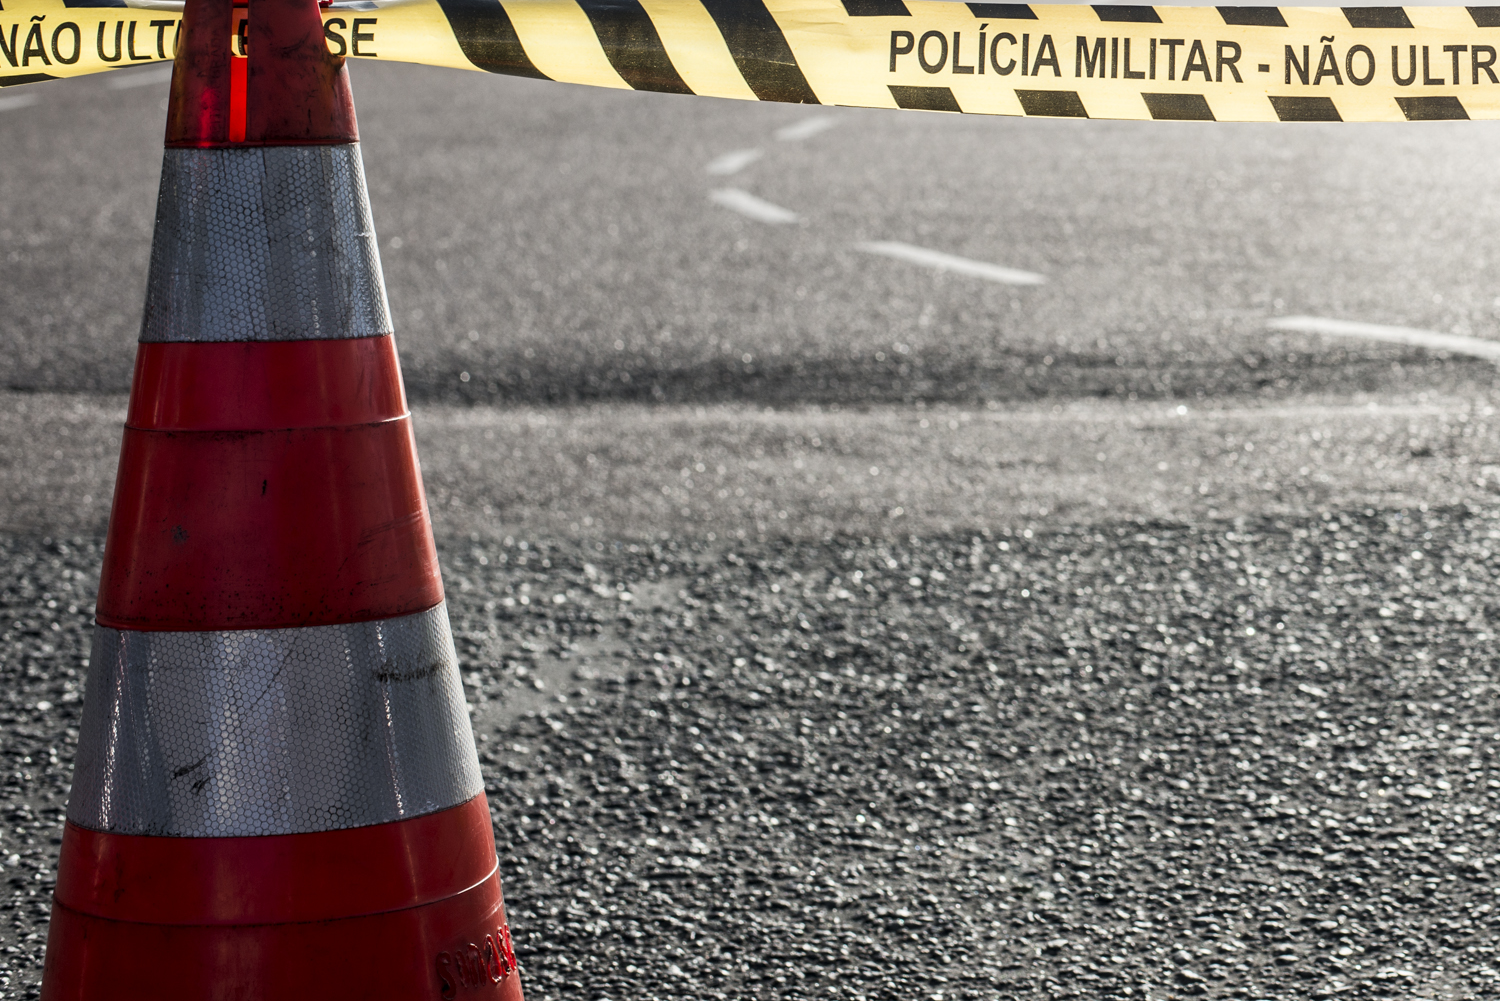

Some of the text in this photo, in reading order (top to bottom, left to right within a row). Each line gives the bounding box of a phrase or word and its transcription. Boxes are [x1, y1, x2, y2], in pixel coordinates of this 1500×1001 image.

[0, 15, 82, 67] NÃO
[889, 23, 1062, 78] POLÍCIA
[1075, 35, 1244, 83] MILITAR
[1257, 64, 1270, 73] -
[1285, 35, 1376, 86] NÃO
